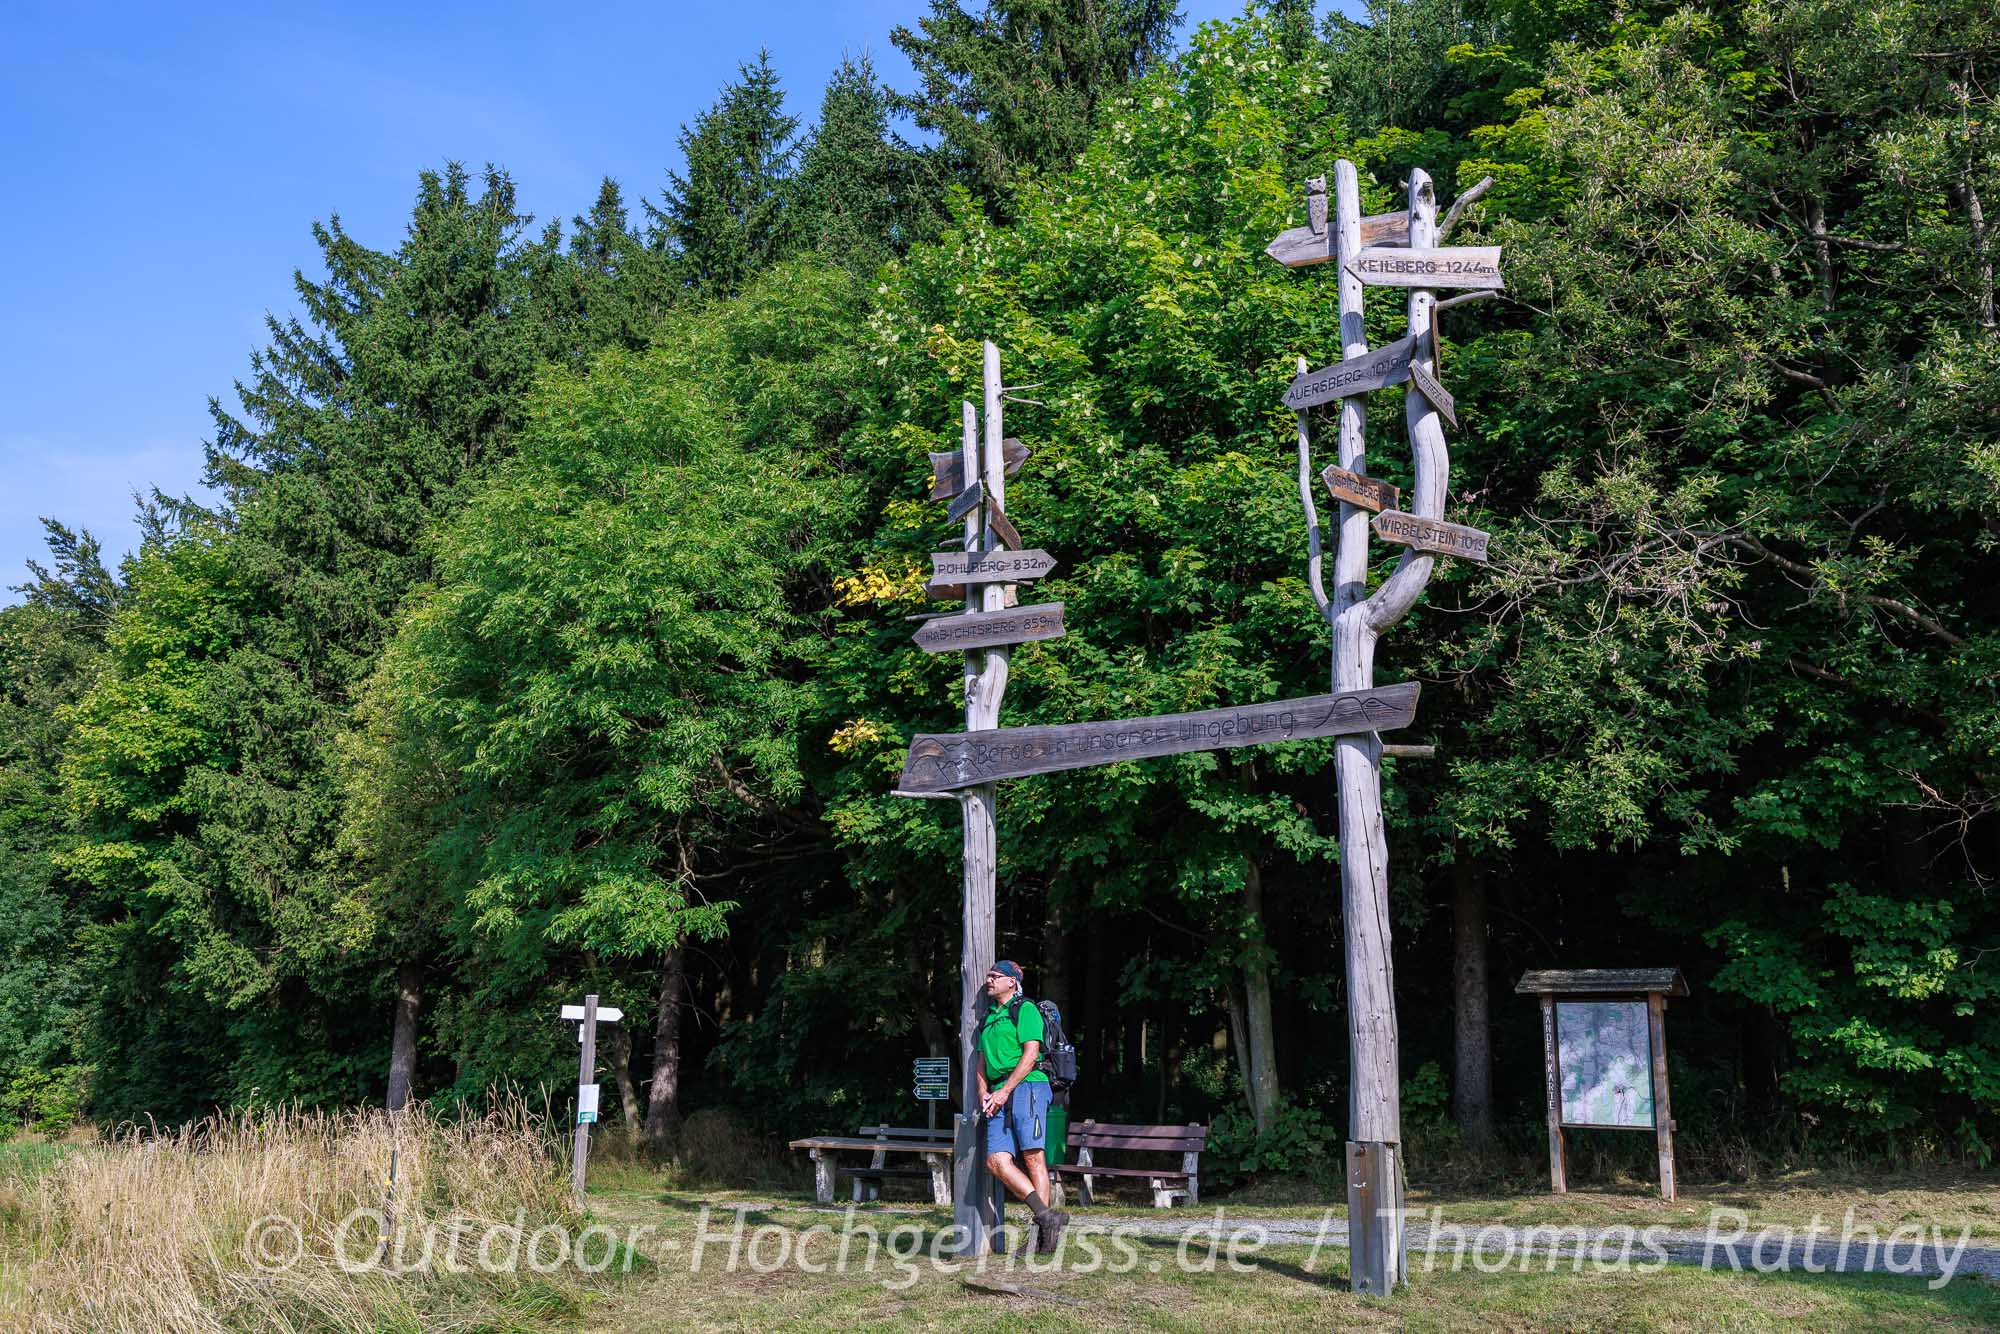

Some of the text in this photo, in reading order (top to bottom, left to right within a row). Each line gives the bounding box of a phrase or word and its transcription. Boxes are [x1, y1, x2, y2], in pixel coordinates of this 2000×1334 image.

[1357, 259, 1496, 275] KEILBERG 1244m
[1287, 369, 1362, 403] AUERSBERG
[1379, 517, 1457, 546] WIRBELSTEIN
[1013, 558, 1048, 571] 832m
[924, 620, 1016, 641] HABICHTSBERG
[977, 742, 1033, 765] Berge
[1179, 710, 1296, 746] Umgebung
